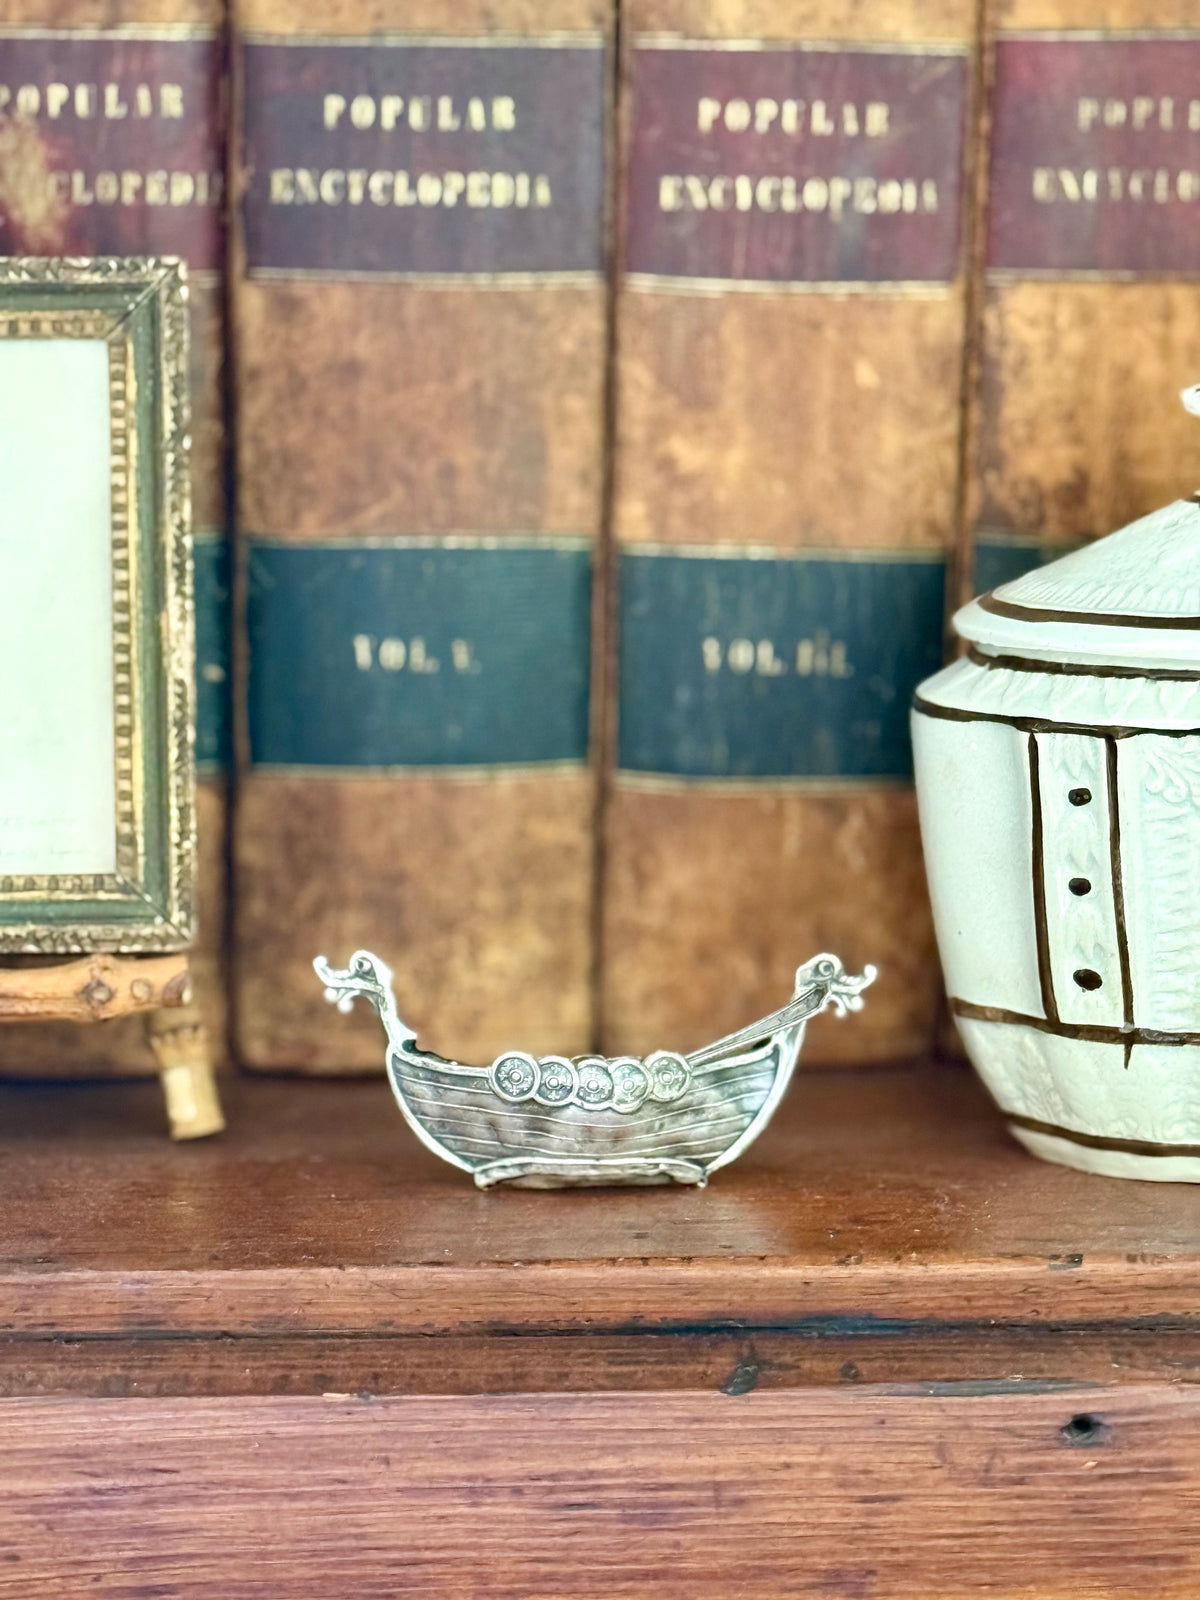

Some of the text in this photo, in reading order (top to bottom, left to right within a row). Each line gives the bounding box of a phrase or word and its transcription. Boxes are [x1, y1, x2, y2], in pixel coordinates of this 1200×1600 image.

[323, 94, 516, 131] POPULAR
[698, 97, 889, 137] POPULAR
[270, 167, 551, 208] ENCYCLOPEDIA
[659, 174, 938, 215] ENCYCLOPEDIA
